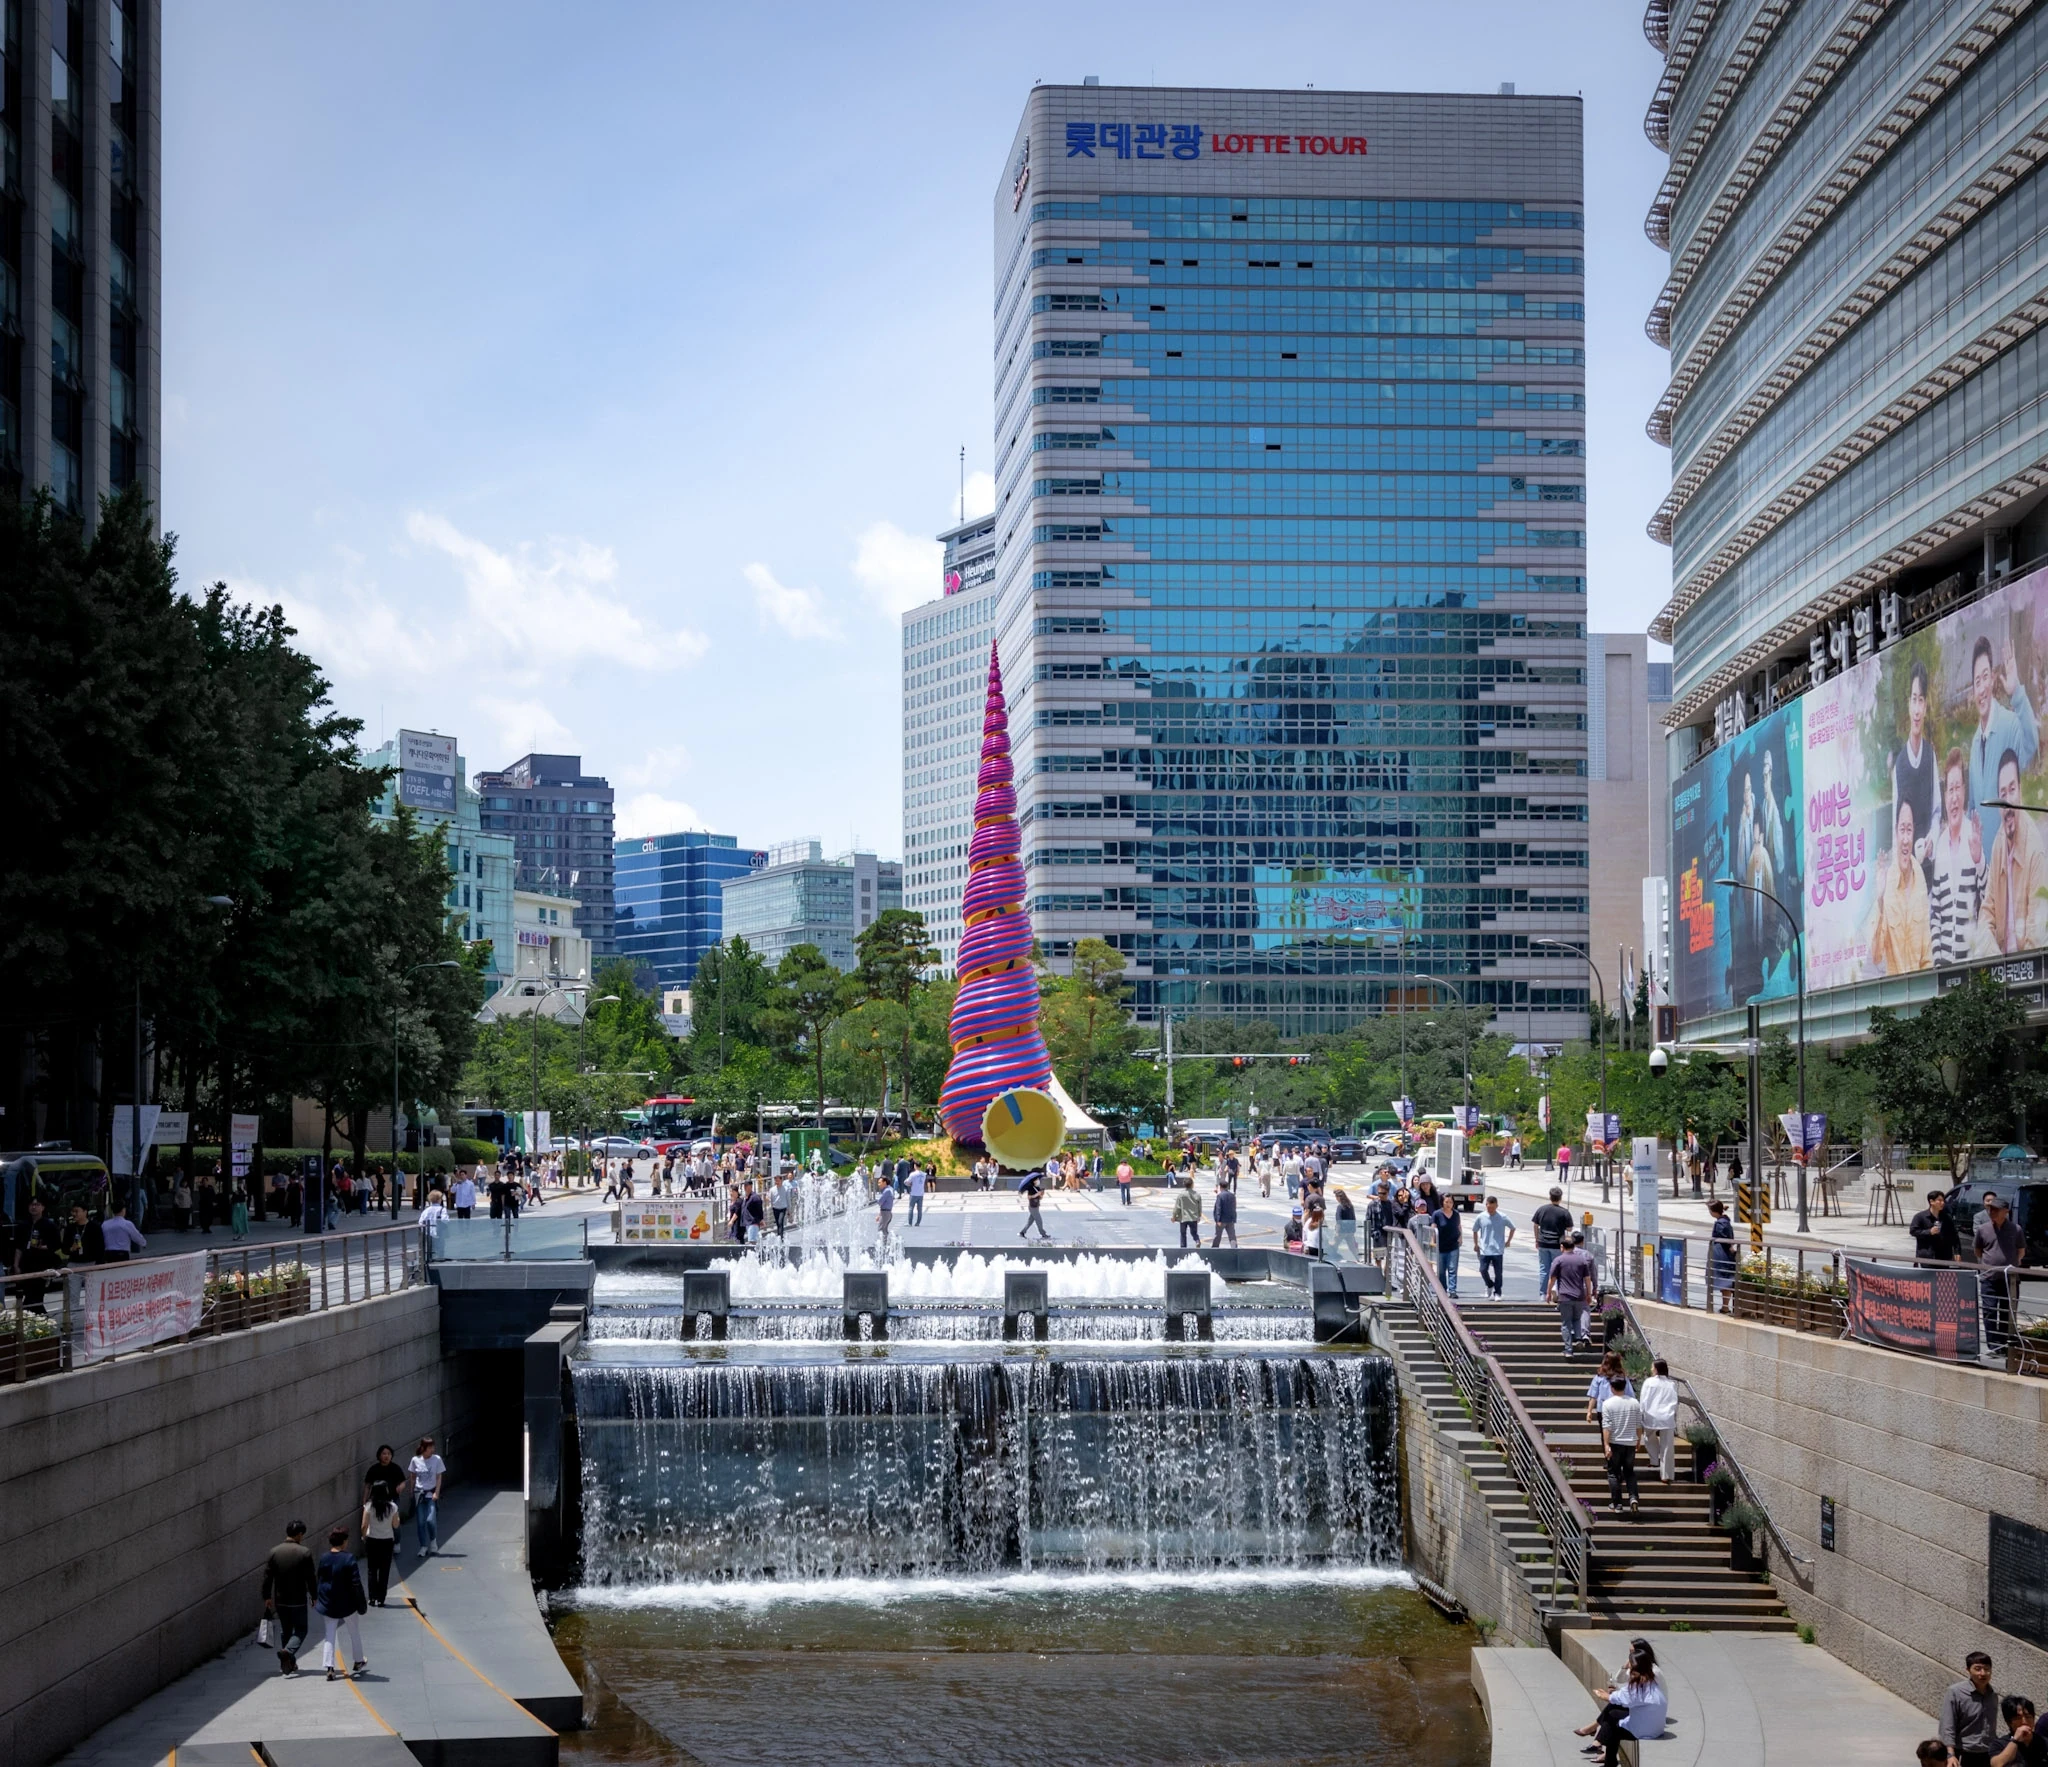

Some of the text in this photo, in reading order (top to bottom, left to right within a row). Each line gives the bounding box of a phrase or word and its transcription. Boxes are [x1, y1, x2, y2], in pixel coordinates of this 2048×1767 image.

[1066, 122, 1203, 160] 롯데관광
[1212, 134, 1368, 155] LOTTE TOUR
[1808, 591, 1903, 688] 동아일보
[406, 784, 431, 796] TOEFL
[1809, 781, 1851, 833] 아빠는
[749, 852, 765, 868] citi
[1811, 828, 1866, 907] 꽃중년
[1644, 1144, 1649, 1156] 1
[107, 1276, 146, 1300] 요르단강부터
